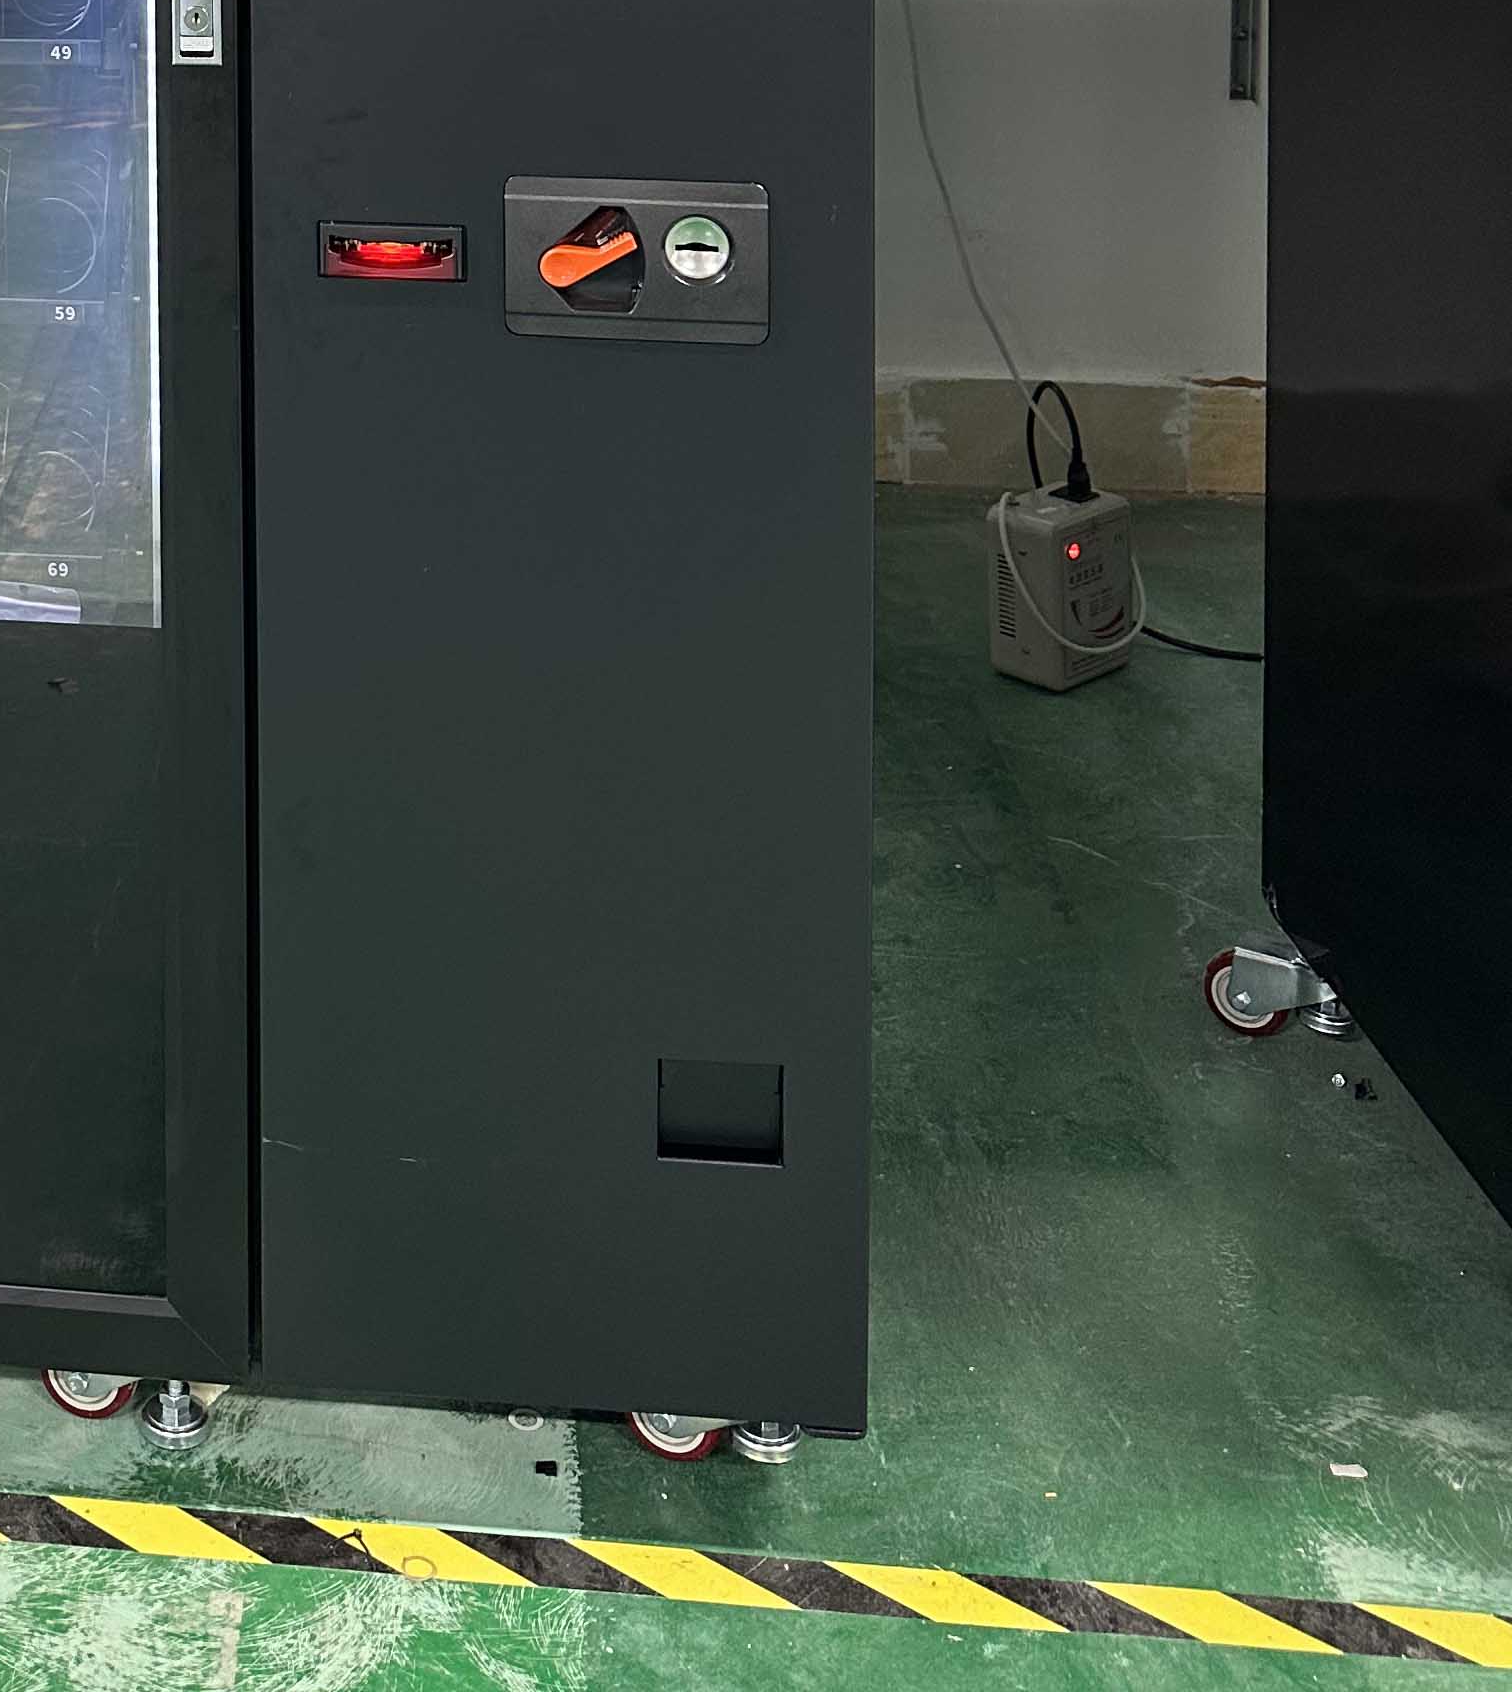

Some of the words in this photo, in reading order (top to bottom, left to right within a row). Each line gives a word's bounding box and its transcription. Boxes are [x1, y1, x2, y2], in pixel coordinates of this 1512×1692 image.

[50, 45, 72, 60] 49
[55, 306, 76, 321] 59
[47, 562, 69, 577] 69
